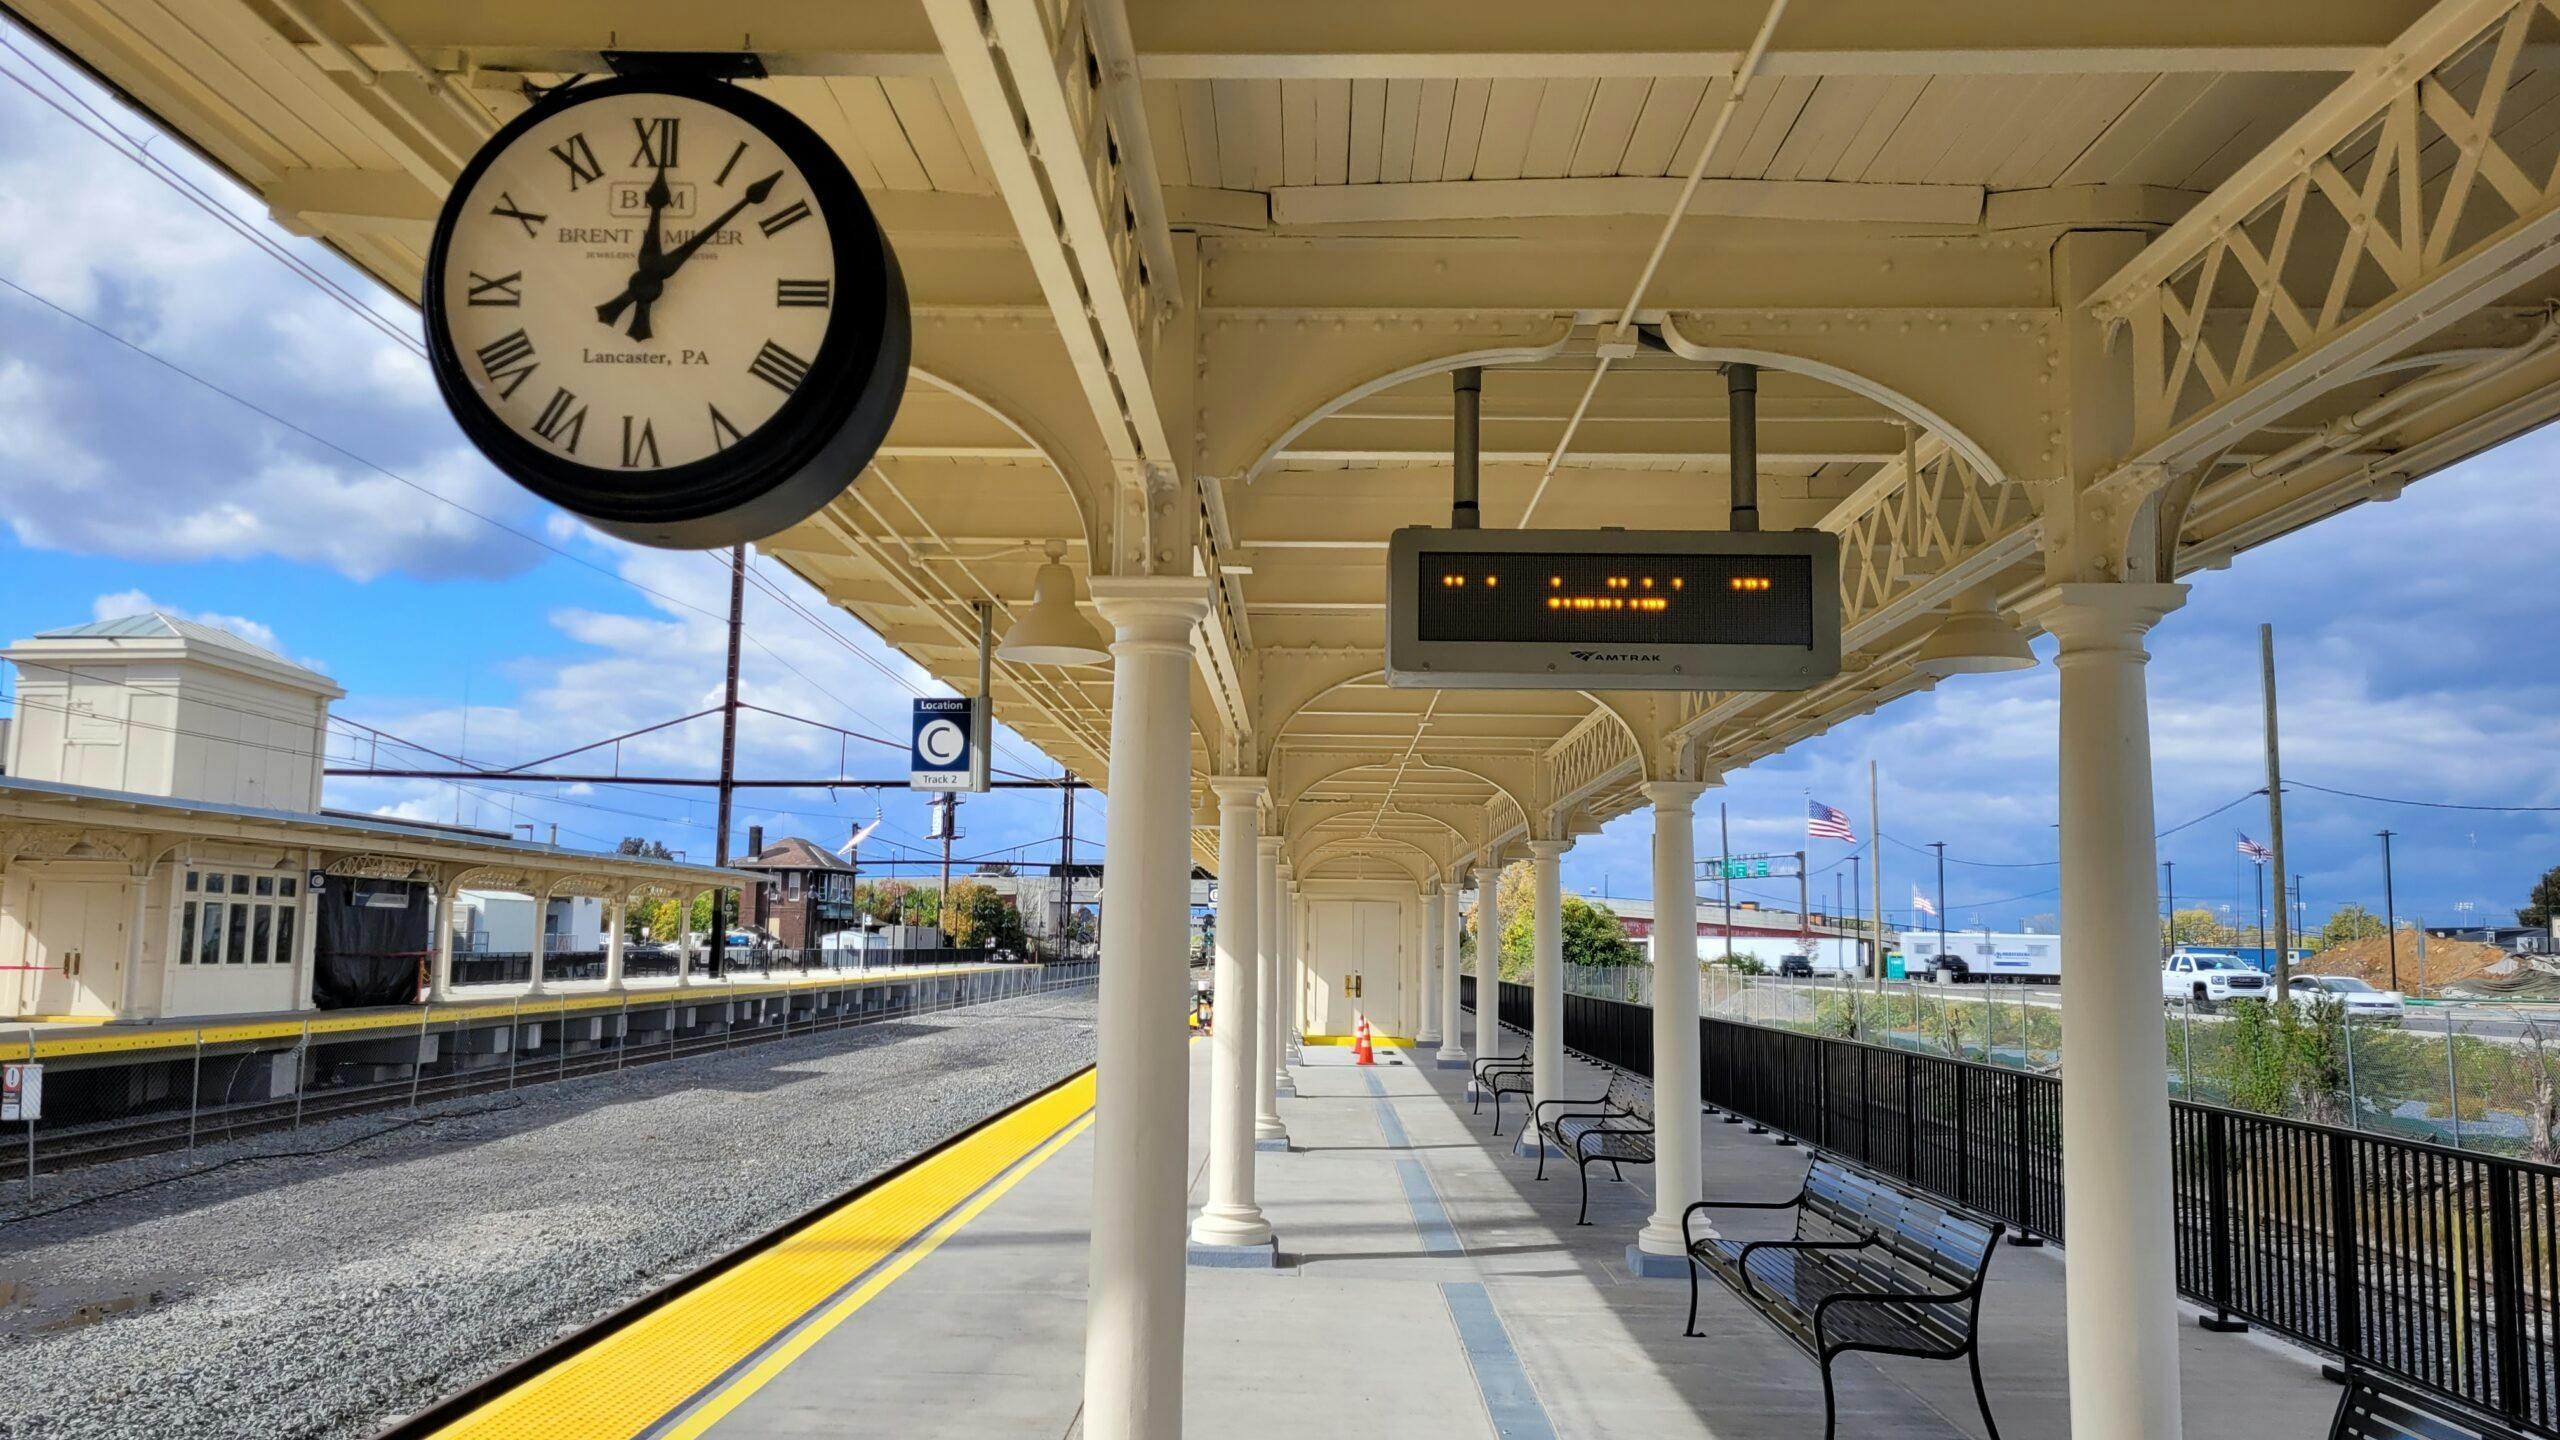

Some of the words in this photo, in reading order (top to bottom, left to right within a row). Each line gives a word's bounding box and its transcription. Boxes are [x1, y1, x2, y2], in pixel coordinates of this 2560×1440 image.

[630, 117, 681, 167] XII
[548, 132, 604, 192] XI
[714, 140, 749, 187] I
[490, 191, 548, 238] X
[620, 189, 685, 209] BM
[558, 227, 632, 244] BRENT
[758, 199, 812, 239] II
[467, 270, 522, 308] IX
[777, 278, 830, 309] III
[476, 328, 541, 401] VIII
[583, 348, 672, 366] Lancaster,
[681, 349, 710, 366] PA
[531, 386, 589, 456] VII
[708, 401, 744, 451] V
[620, 415, 663, 468] VI
[1595, 654, 1661, 662] AMTRAK
[921, 700, 963, 710] Location
[927, 726, 950, 758] C
[923, 775, 949, 784] Track
[951, 775, 958, 784] 2
